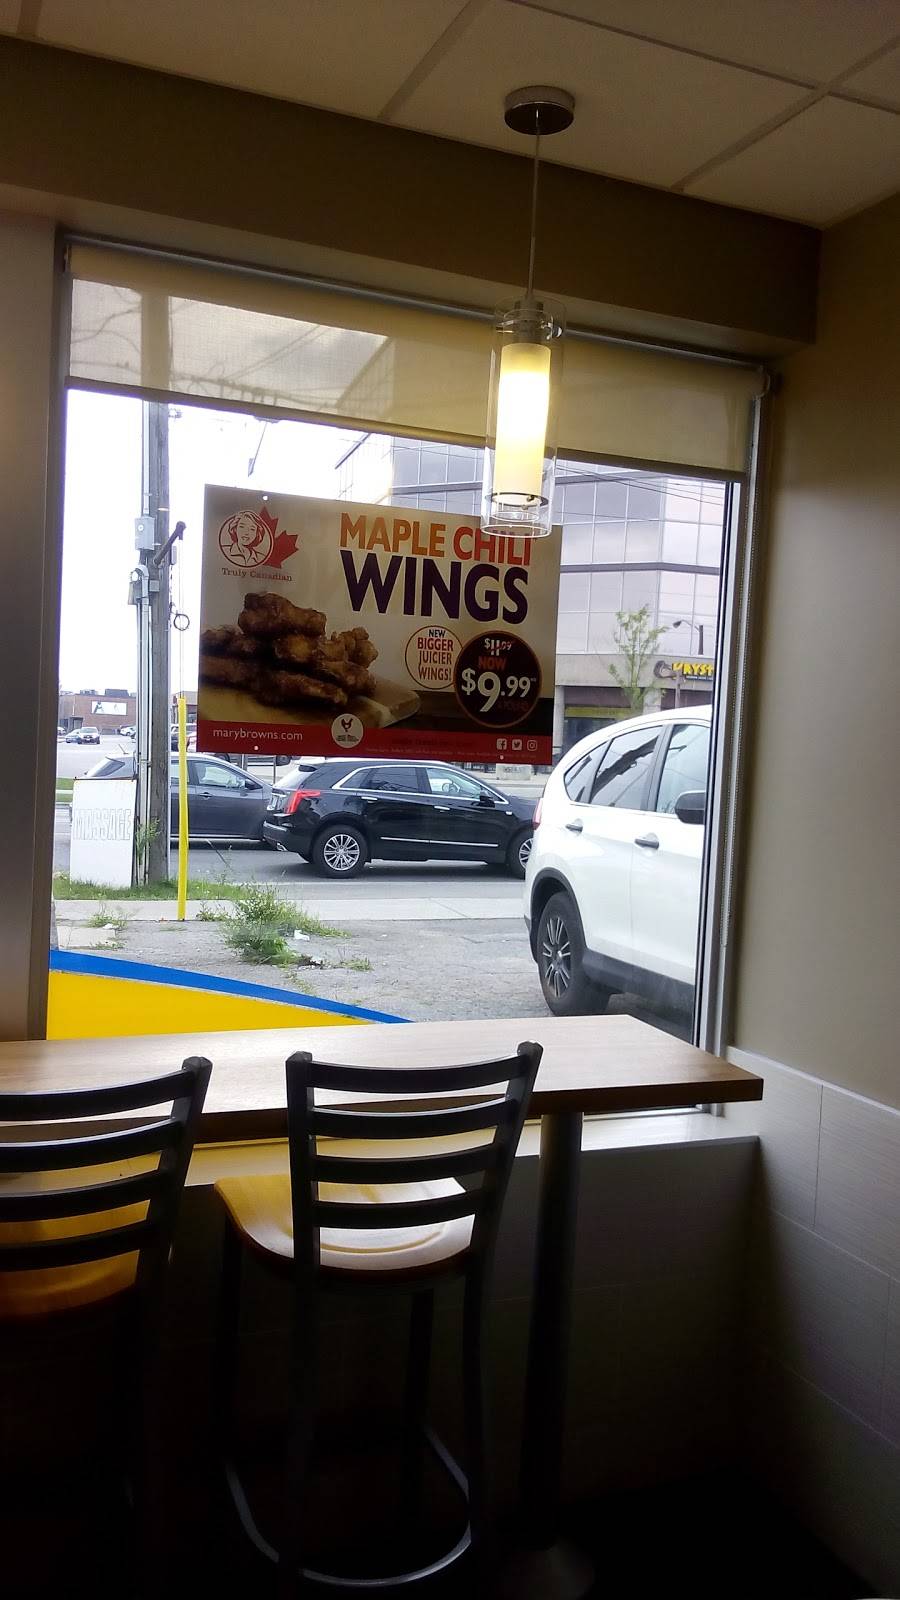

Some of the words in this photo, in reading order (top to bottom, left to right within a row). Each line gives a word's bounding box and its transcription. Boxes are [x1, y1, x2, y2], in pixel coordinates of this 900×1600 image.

[339, 512, 446, 558] MAPLE
[453, 526, 531, 566] CHILI
[221, 567, 247, 578] Truly
[249, 570, 292, 582] Canadian
[340, 549, 529, 625] WINGS
[428, 629, 446, 639] NEW
[417, 636, 454, 652] BIGGER
[419, 651, 452, 666] JUICIER
[479, 657, 506, 670] NOW
[418, 665, 452, 681] WINGS!
[461, 667, 531, 712] $9.99
[212, 728, 303, 741] marybrowns.com
[73, 808, 132, 841] MASSAGE
